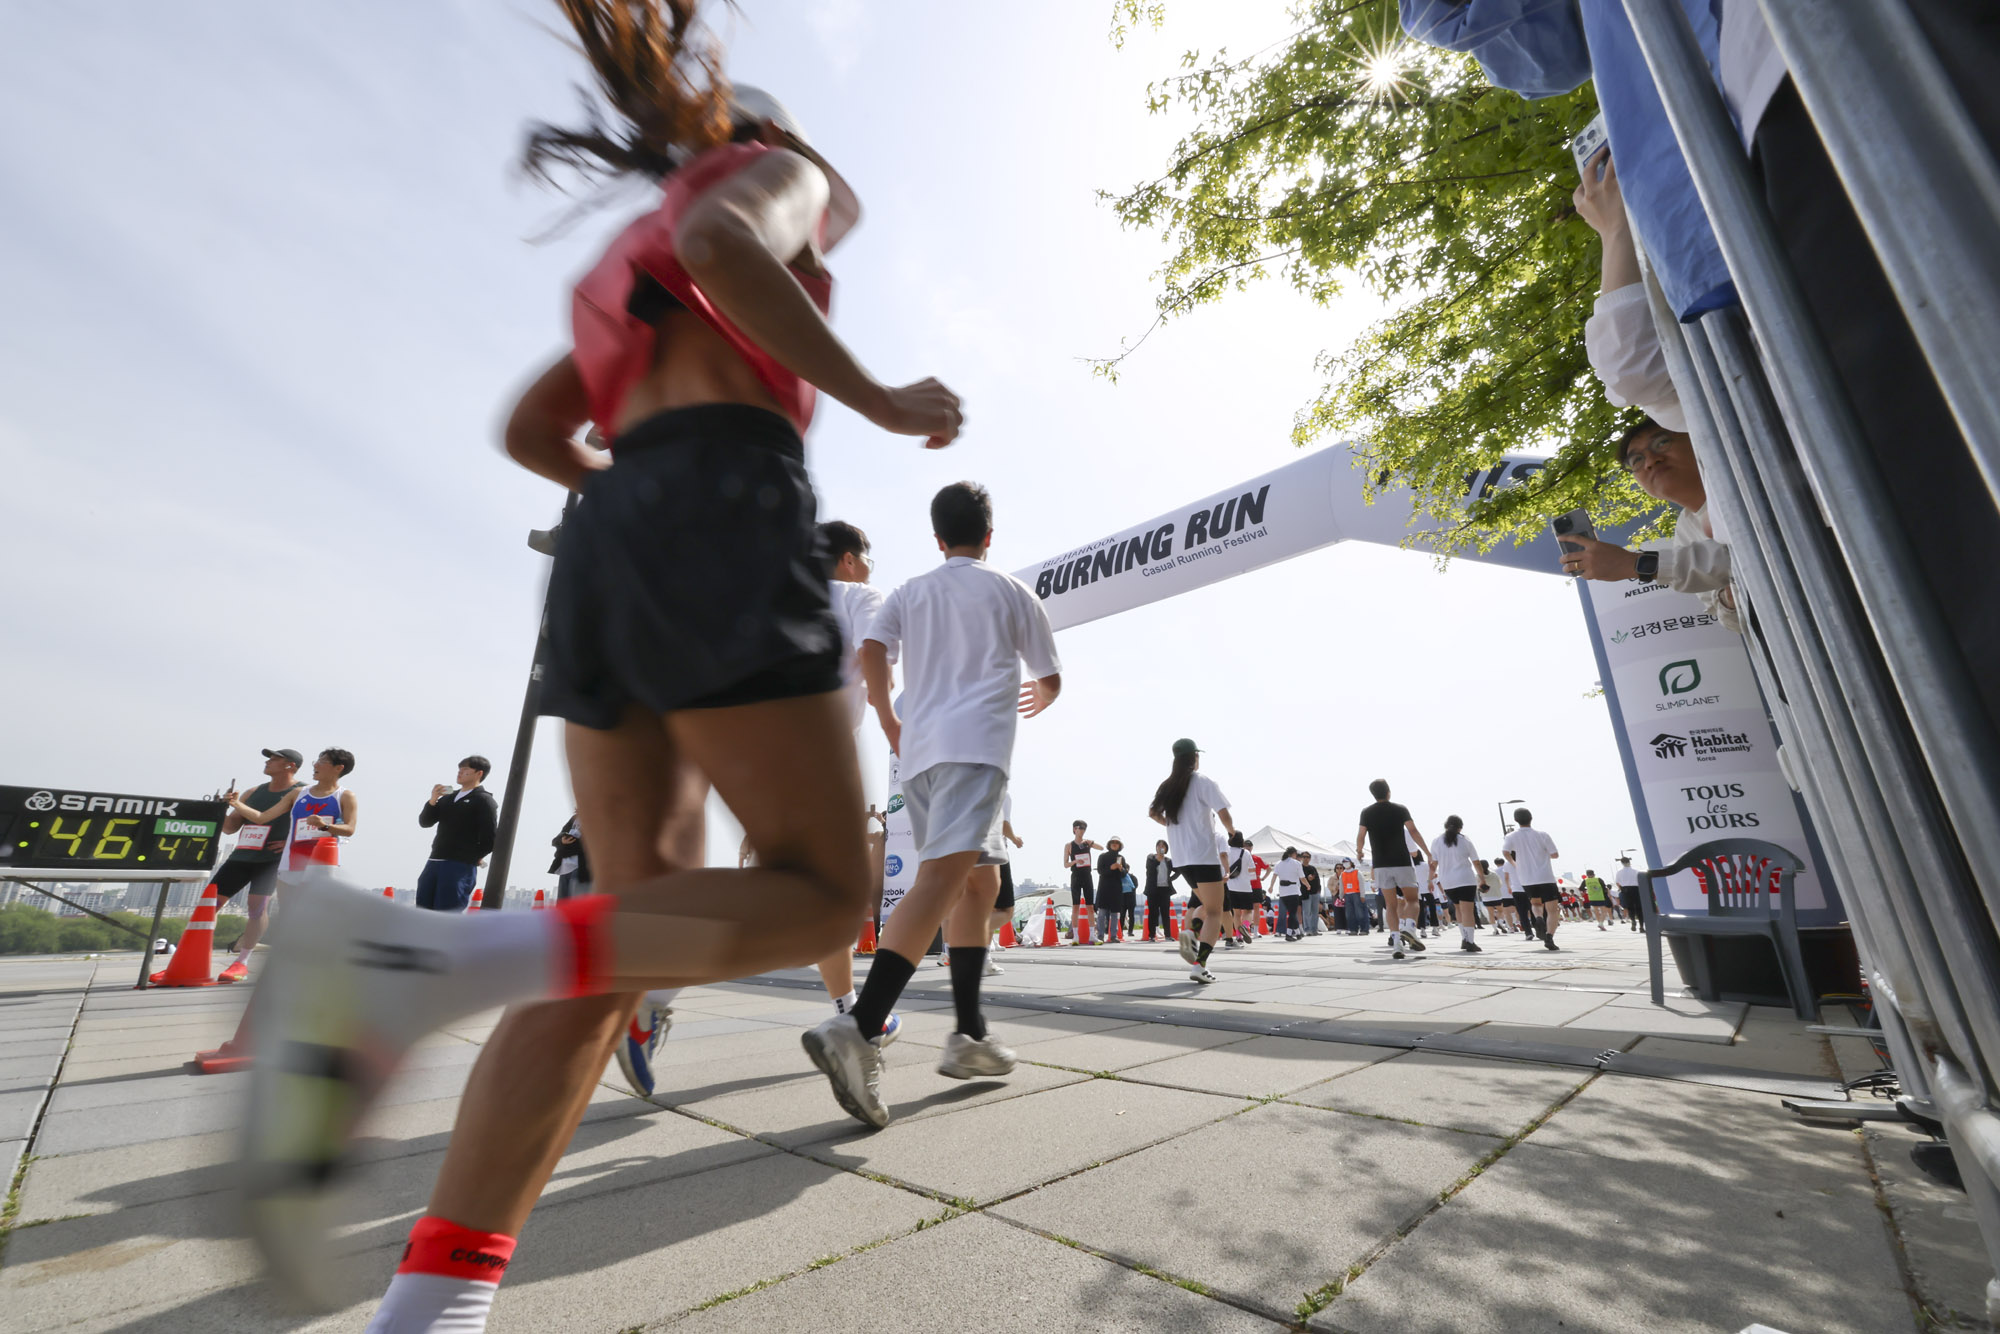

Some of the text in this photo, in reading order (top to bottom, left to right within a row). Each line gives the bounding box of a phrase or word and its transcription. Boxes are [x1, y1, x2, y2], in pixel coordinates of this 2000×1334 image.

[1035, 484, 1270, 600] BURNING RUN
[1142, 526, 1268, 578] Casual Running Festival
[1655, 695, 1720, 711] SLIMPLANET
[1691, 733, 1749, 748] Habitat
[1681, 783, 1745, 802] TOUS
[60, 794, 179, 817] SAMIK
[1706, 800, 1728, 814] les
[164, 820, 207, 834] 10km
[1686, 812, 1760, 833] JOURS
